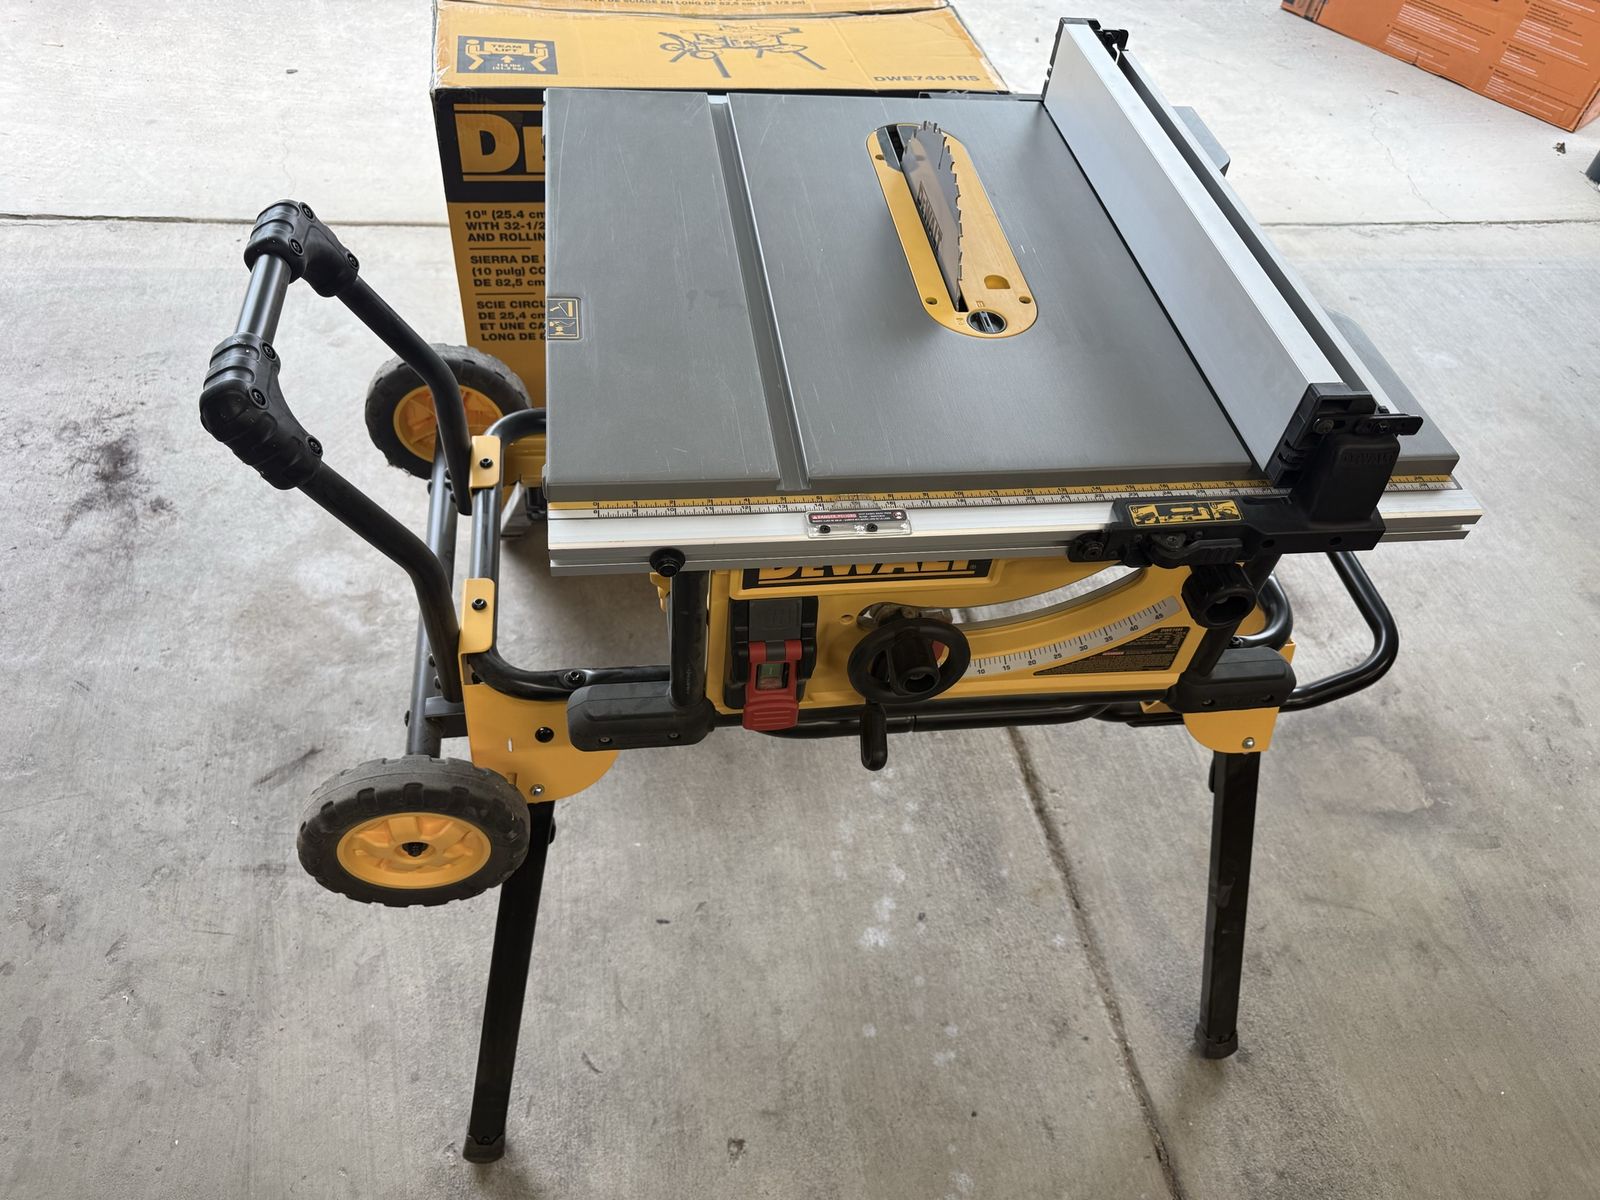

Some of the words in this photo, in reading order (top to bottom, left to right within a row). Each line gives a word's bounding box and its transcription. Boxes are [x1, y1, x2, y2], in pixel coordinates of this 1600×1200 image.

[465, 210, 487, 220] 10"
[492, 210, 525, 220] (25.4
[465, 222, 500, 231] WITH
[467, 233, 496, 242] AND
[470, 255, 518, 264] SIERRA
[522, 255, 540, 263] DE
[472, 267, 492, 277] (10
[496, 267, 525, 277] pulg)
[473, 278, 492, 287] DE
[496, 278, 523, 288] 82,5
[477, 300, 506, 309] SCIE
[479, 312, 496, 320] DE
[500, 311, 526, 321] 25,4
[480, 322, 496, 331] ET
[500, 322, 526, 330] UNE
[481, 333, 516, 341] LONG
[519, 332, 536, 340] DE
